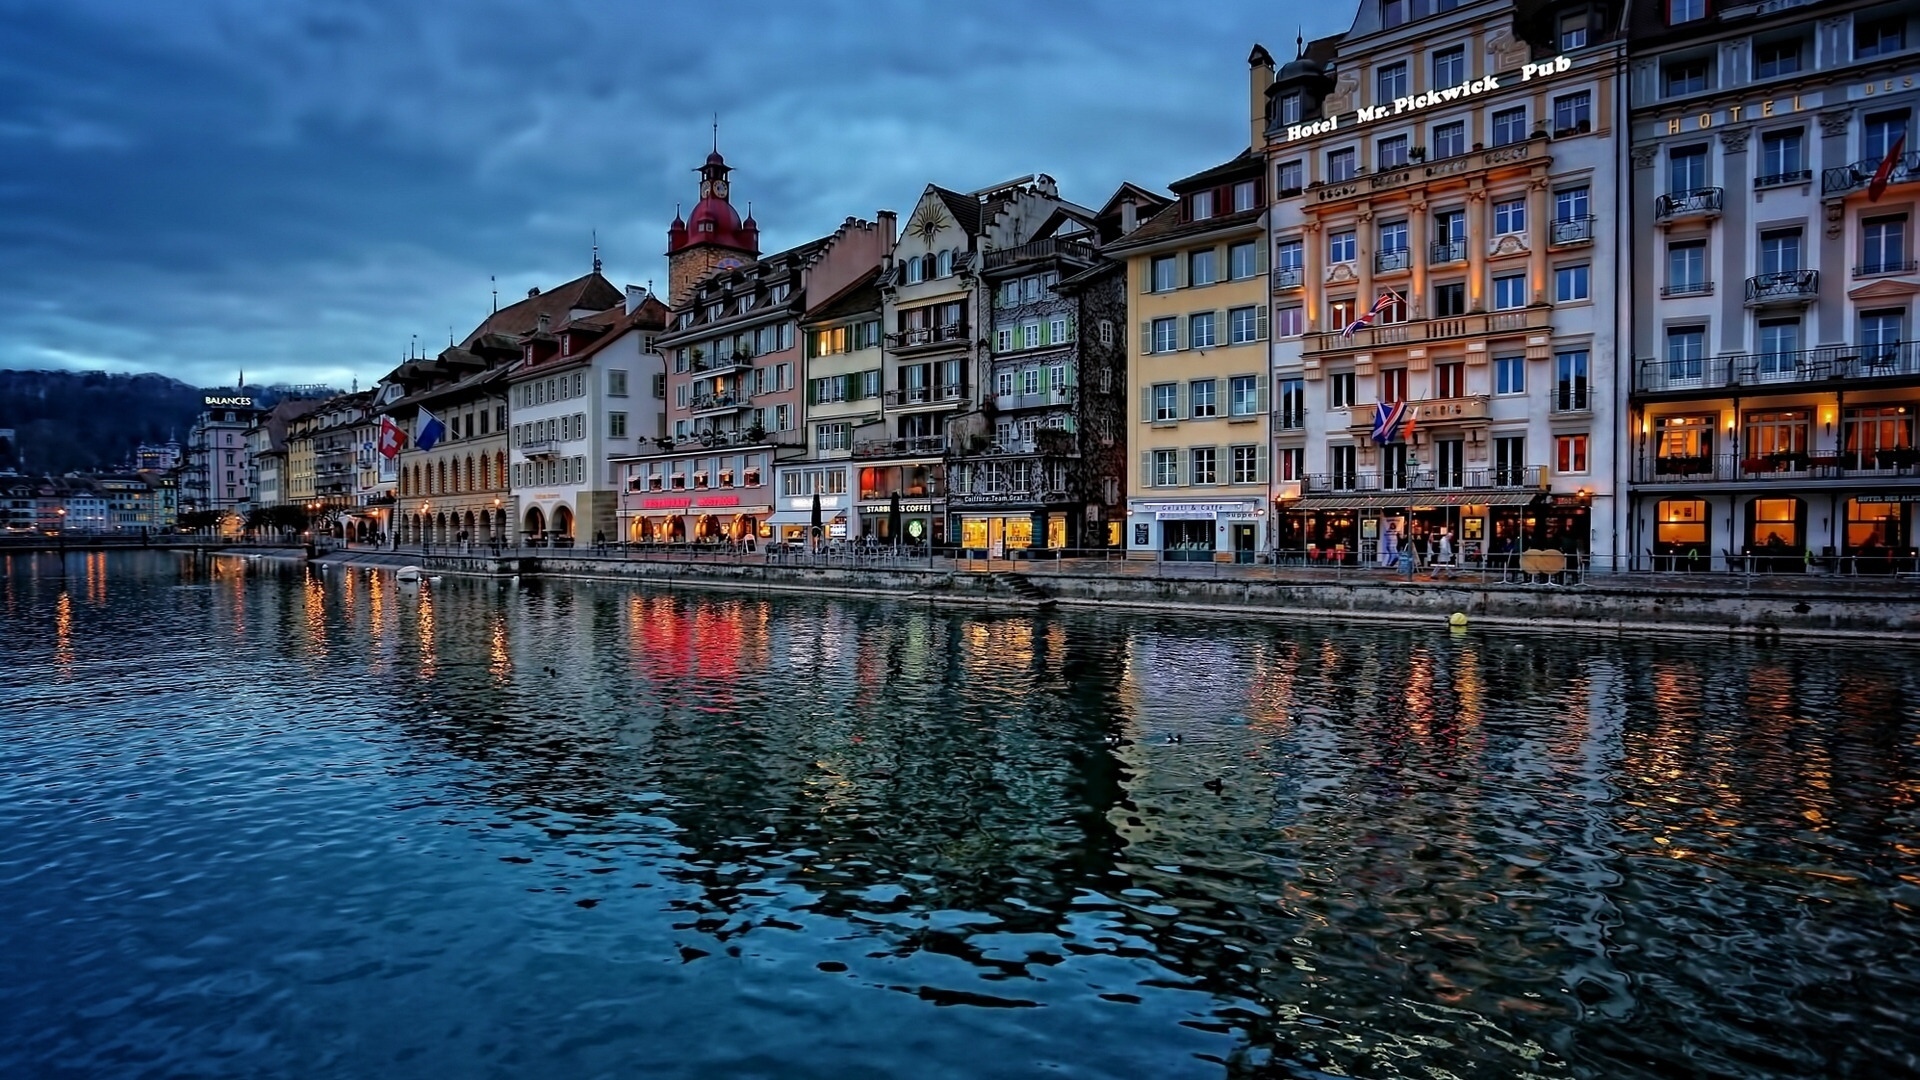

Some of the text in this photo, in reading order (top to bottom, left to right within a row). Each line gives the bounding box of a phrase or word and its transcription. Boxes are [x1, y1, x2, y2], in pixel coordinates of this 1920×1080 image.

[1287, 55, 1572, 142] Hotel Mr. Pickwick Pub
[1668, 77, 1913, 135] HOTEL DES
[205, 396, 251, 406] BALANCES
[866, 505, 905, 513] STARBS
